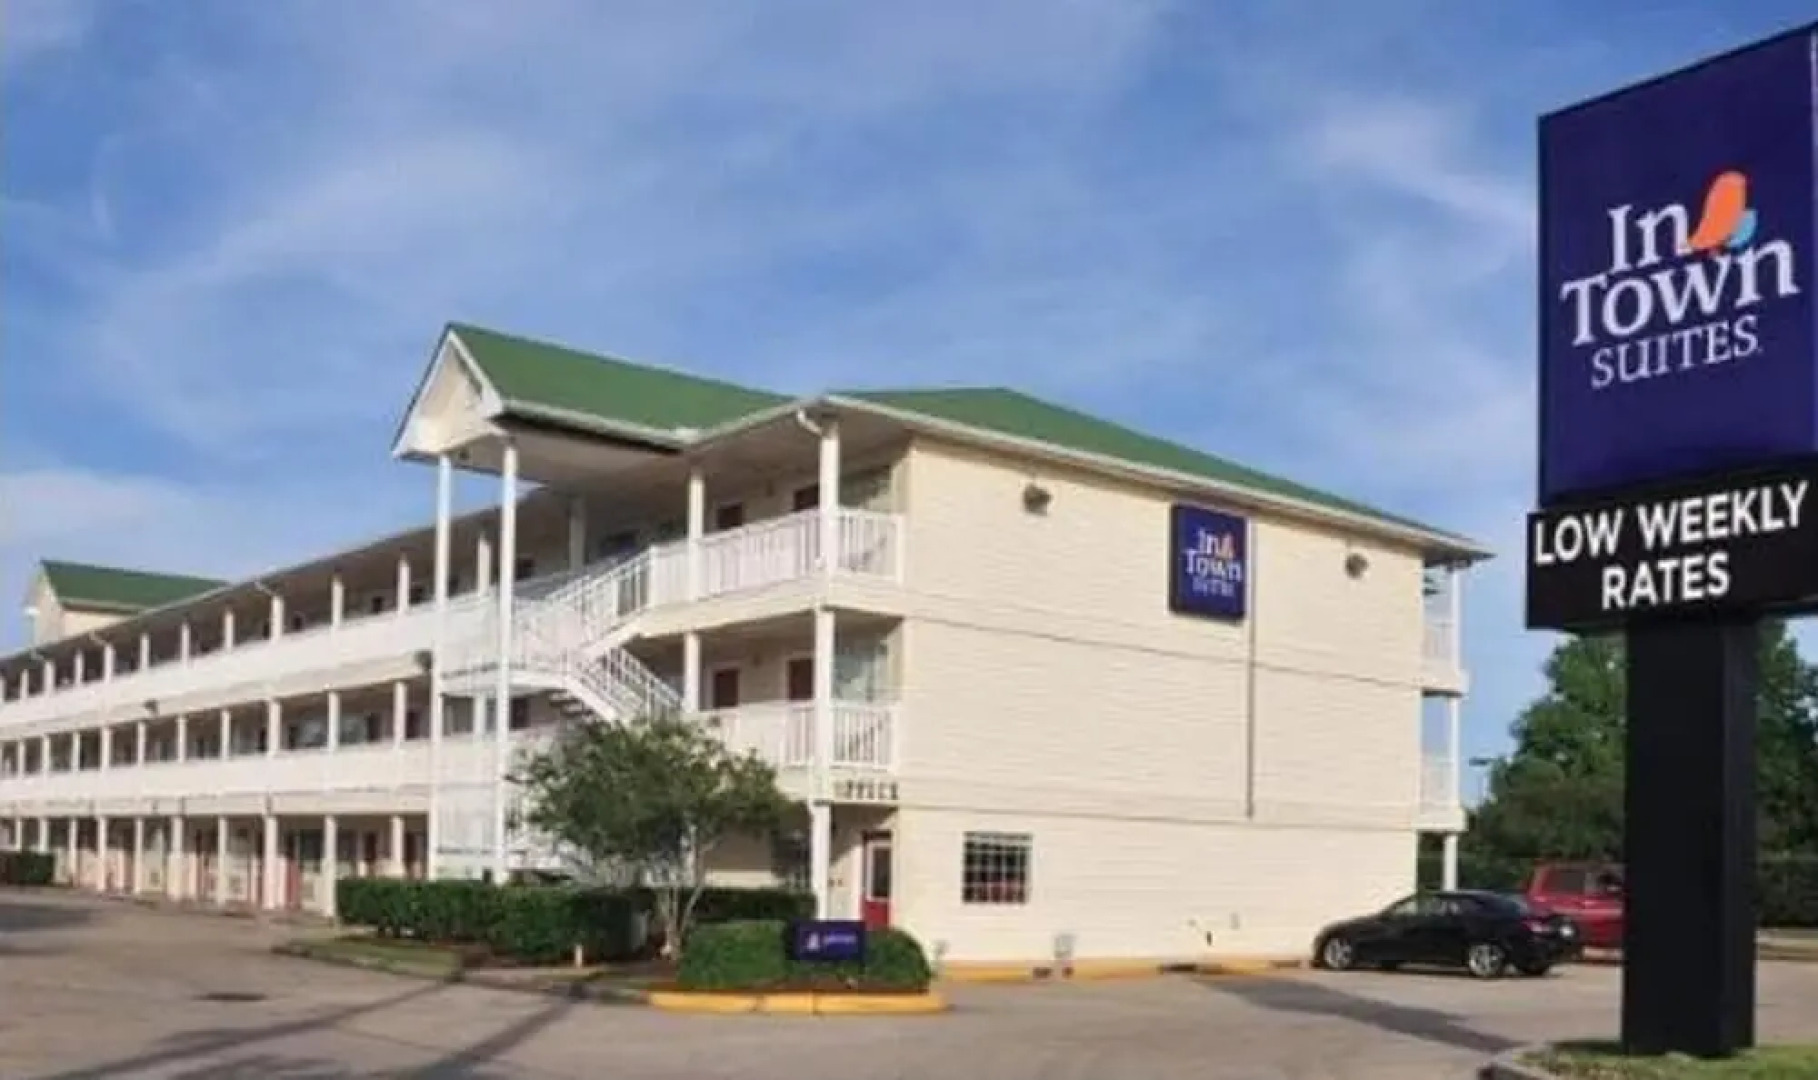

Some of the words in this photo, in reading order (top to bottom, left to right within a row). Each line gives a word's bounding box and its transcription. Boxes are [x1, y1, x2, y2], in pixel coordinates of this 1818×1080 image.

[1607, 204, 1692, 274] In
[1560, 238, 1801, 347] Town
[1591, 315, 1759, 389] SUITES
[1535, 509, 1623, 564] LOW
[1638, 481, 1809, 551] WEEKLY
[1601, 553, 1730, 610] RATES
